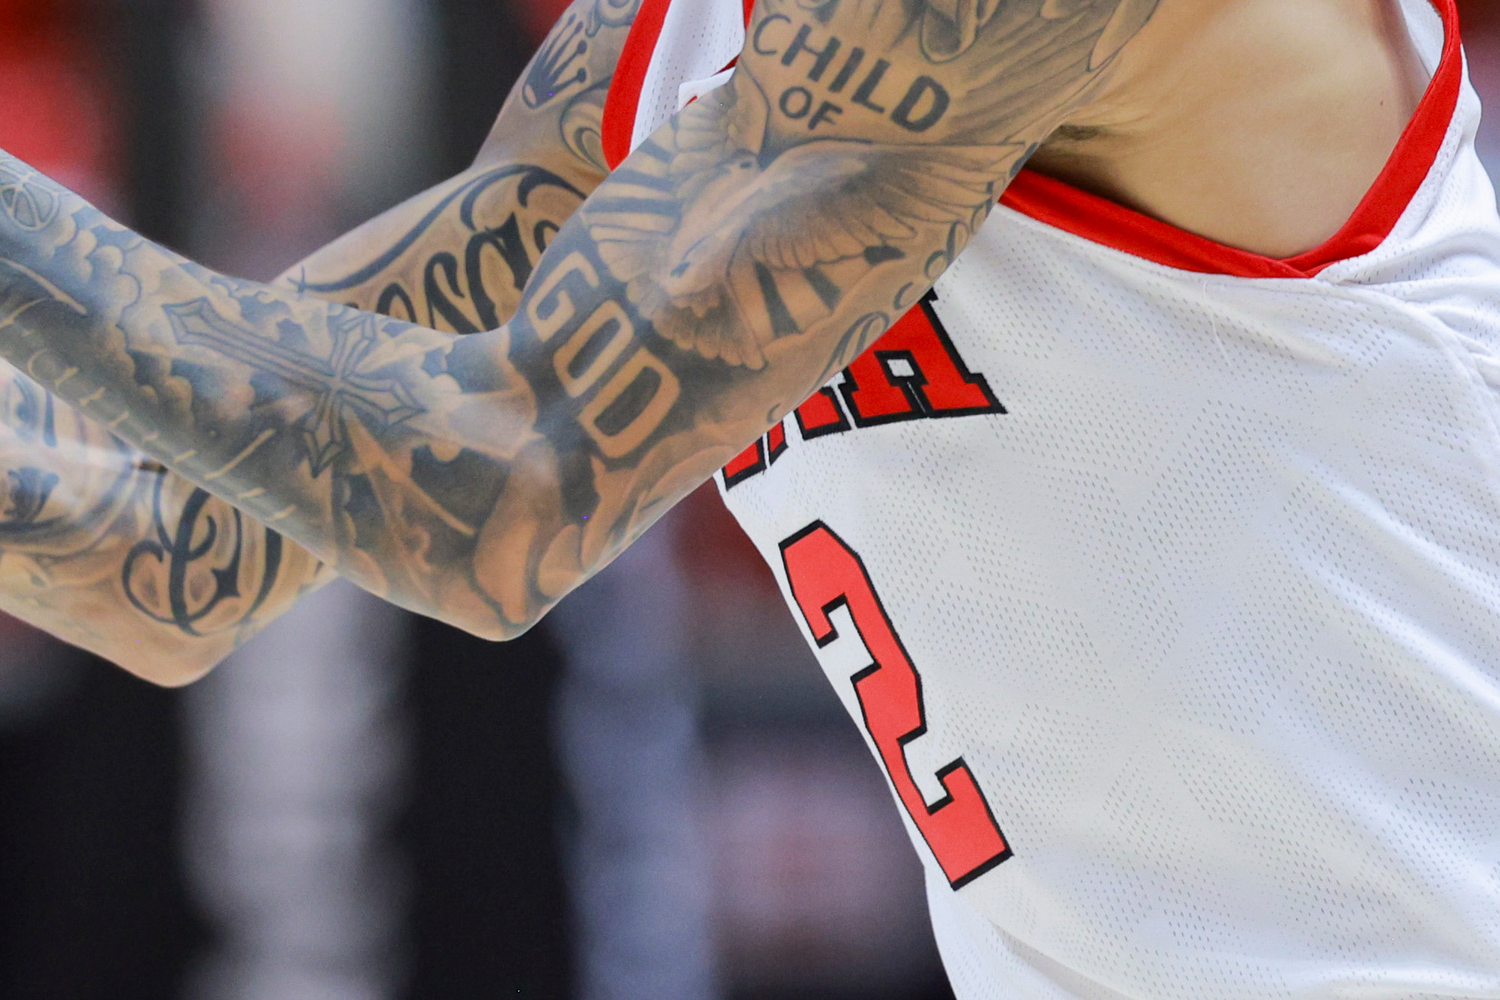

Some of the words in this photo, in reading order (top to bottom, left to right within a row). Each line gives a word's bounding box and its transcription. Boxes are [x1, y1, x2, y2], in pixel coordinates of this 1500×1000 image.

[752, 13, 950, 133] CHILD
[778, 85, 844, 131] OF
[525, 250, 682, 460] GOD
[777, 517, 1014, 892] 2
